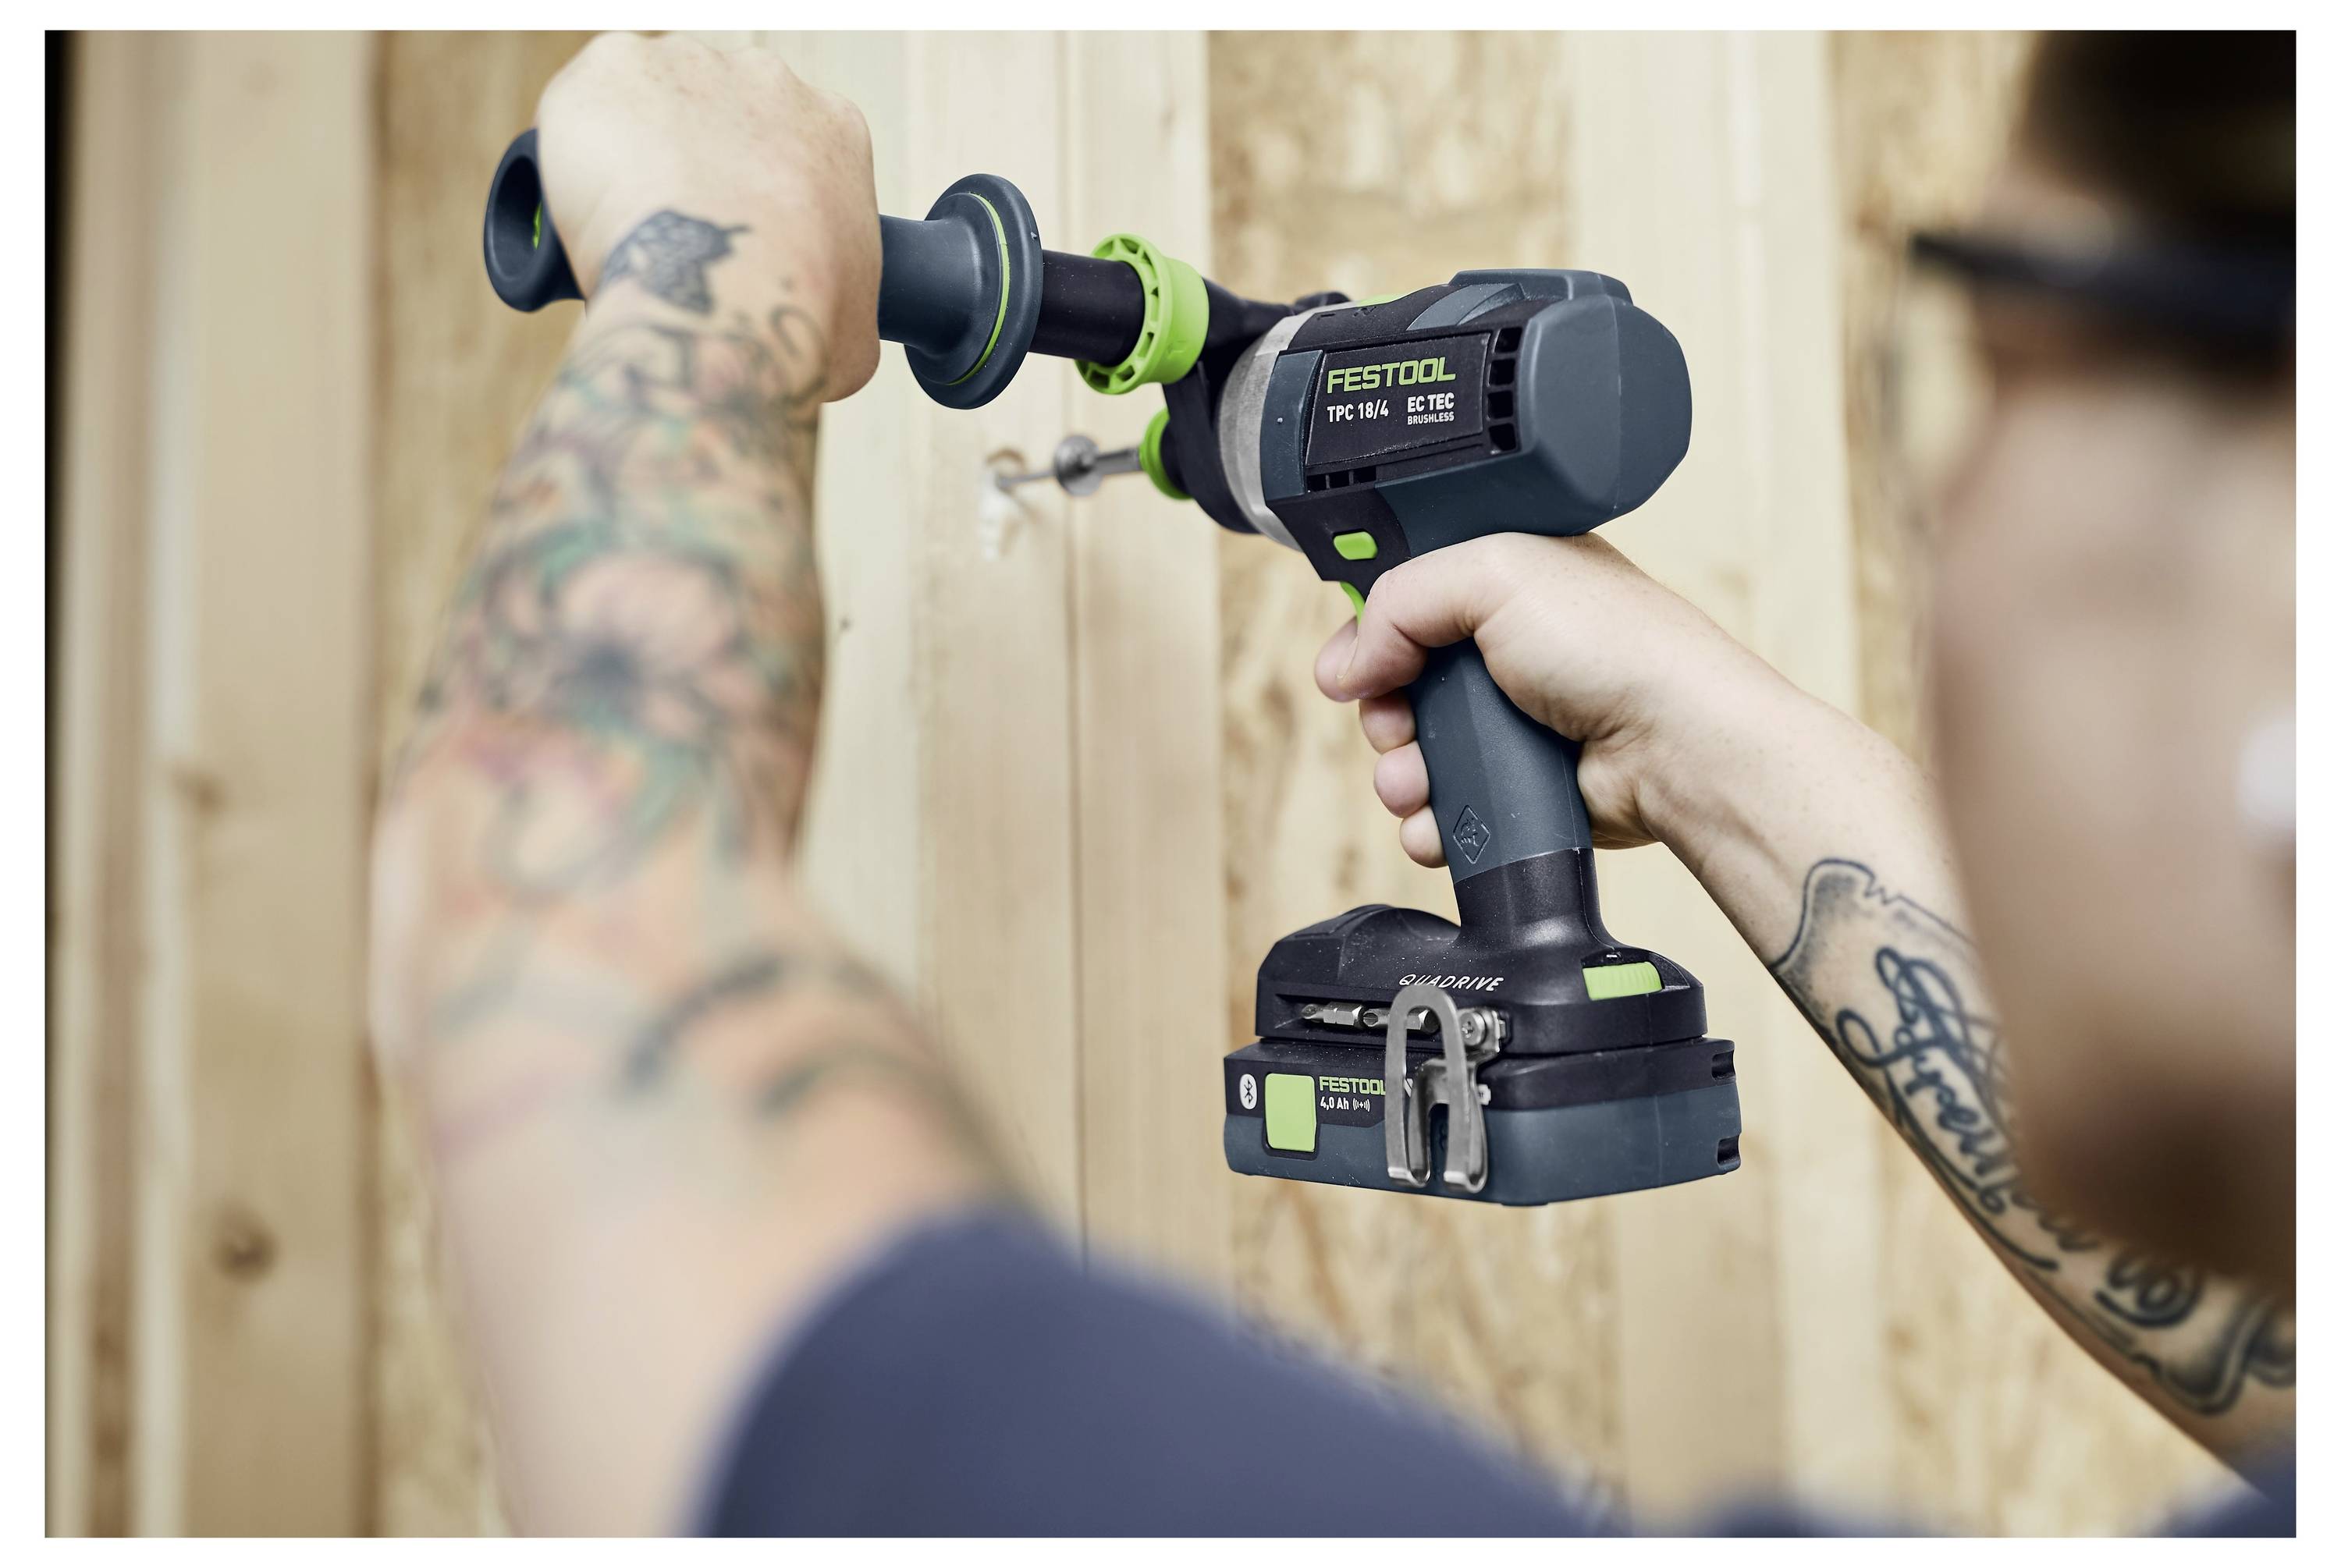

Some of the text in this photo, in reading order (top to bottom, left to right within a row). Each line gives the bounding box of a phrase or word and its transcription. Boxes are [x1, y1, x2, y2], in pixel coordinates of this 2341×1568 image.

[1327, 357, 1456, 393] FESTOOL
[1327, 399, 1389, 422] TPC 18/4
[1407, 392, 1455, 413] EC TEC
[1407, 411, 1455, 425] BRUSHLESS
[1399, 974, 1504, 992] QUADRIVE
[1319, 1076, 1386, 1095] FESTOOL
[1320, 1096, 1349, 1111] 4,0 Ah
